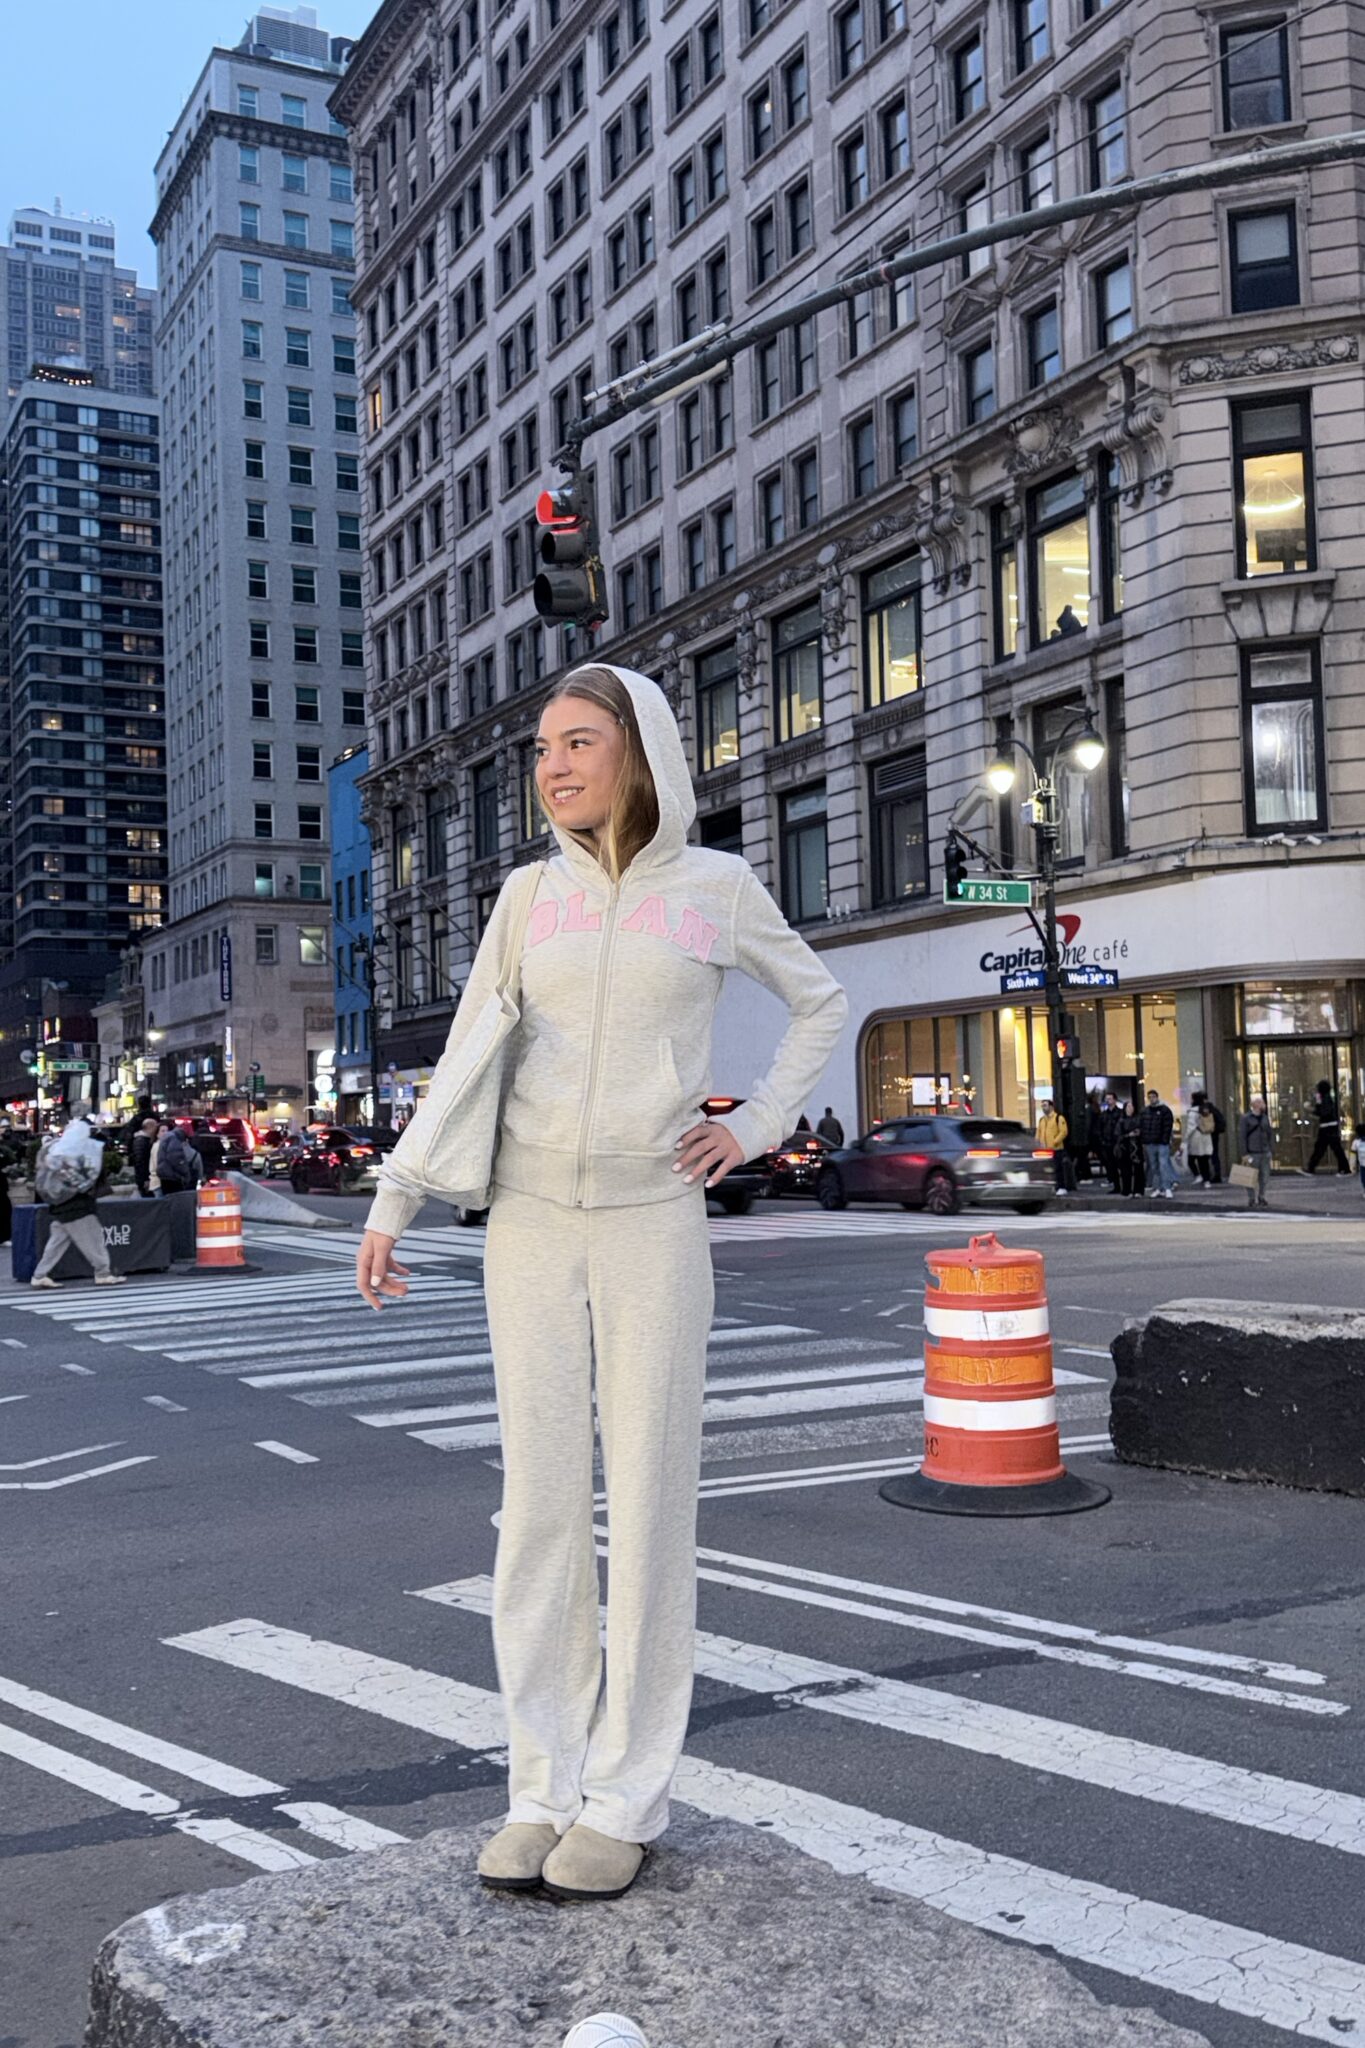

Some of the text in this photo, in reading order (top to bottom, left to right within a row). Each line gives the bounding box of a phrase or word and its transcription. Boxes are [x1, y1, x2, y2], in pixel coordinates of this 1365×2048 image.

[979, 885, 992, 901] 34
[996, 885, 1008, 901] St
[980, 945, 1044, 975] Capita
[1093, 939, 1129, 962] café
[1006, 976, 1039, 990] Sixth Ave
[1067, 972, 1089, 985] West
[1105, 973, 1115, 985] St
